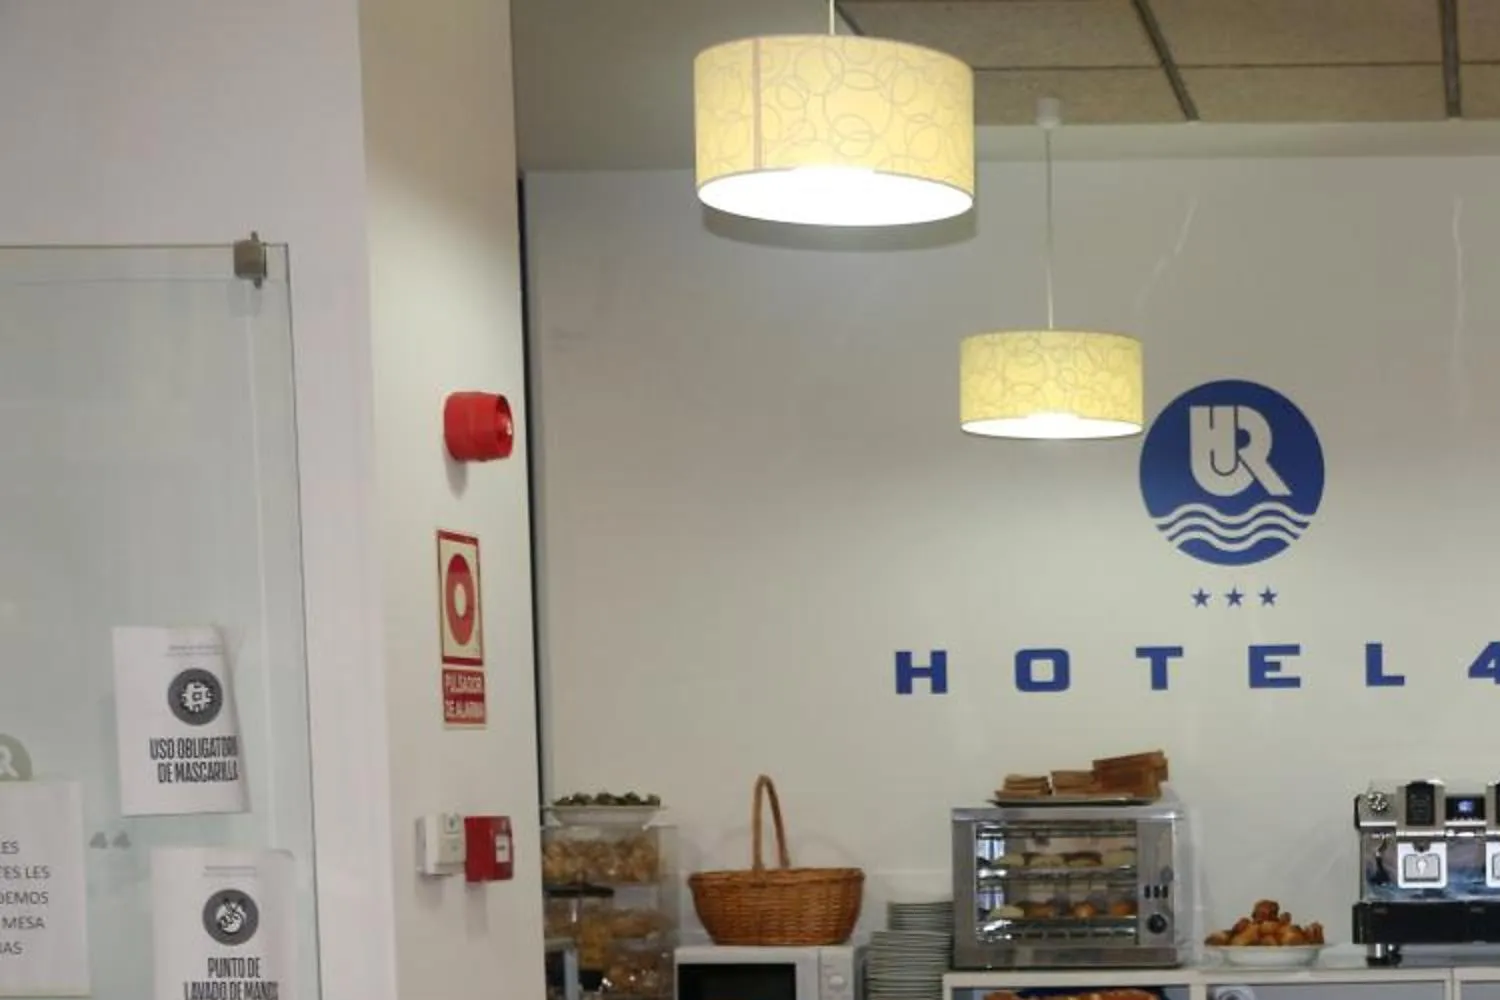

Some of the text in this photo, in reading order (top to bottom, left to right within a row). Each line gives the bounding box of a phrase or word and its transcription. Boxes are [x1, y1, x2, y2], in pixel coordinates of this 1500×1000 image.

[894, 642, 1406, 695] HOTEL
[149, 737, 175, 761] USO
[157, 762, 173, 783] DE
[25, 865, 51, 879] LES
[2, 916, 46, 930] MESA
[0, 941, 23, 955] AS
[207, 956, 261, 979] PUNTO DE
